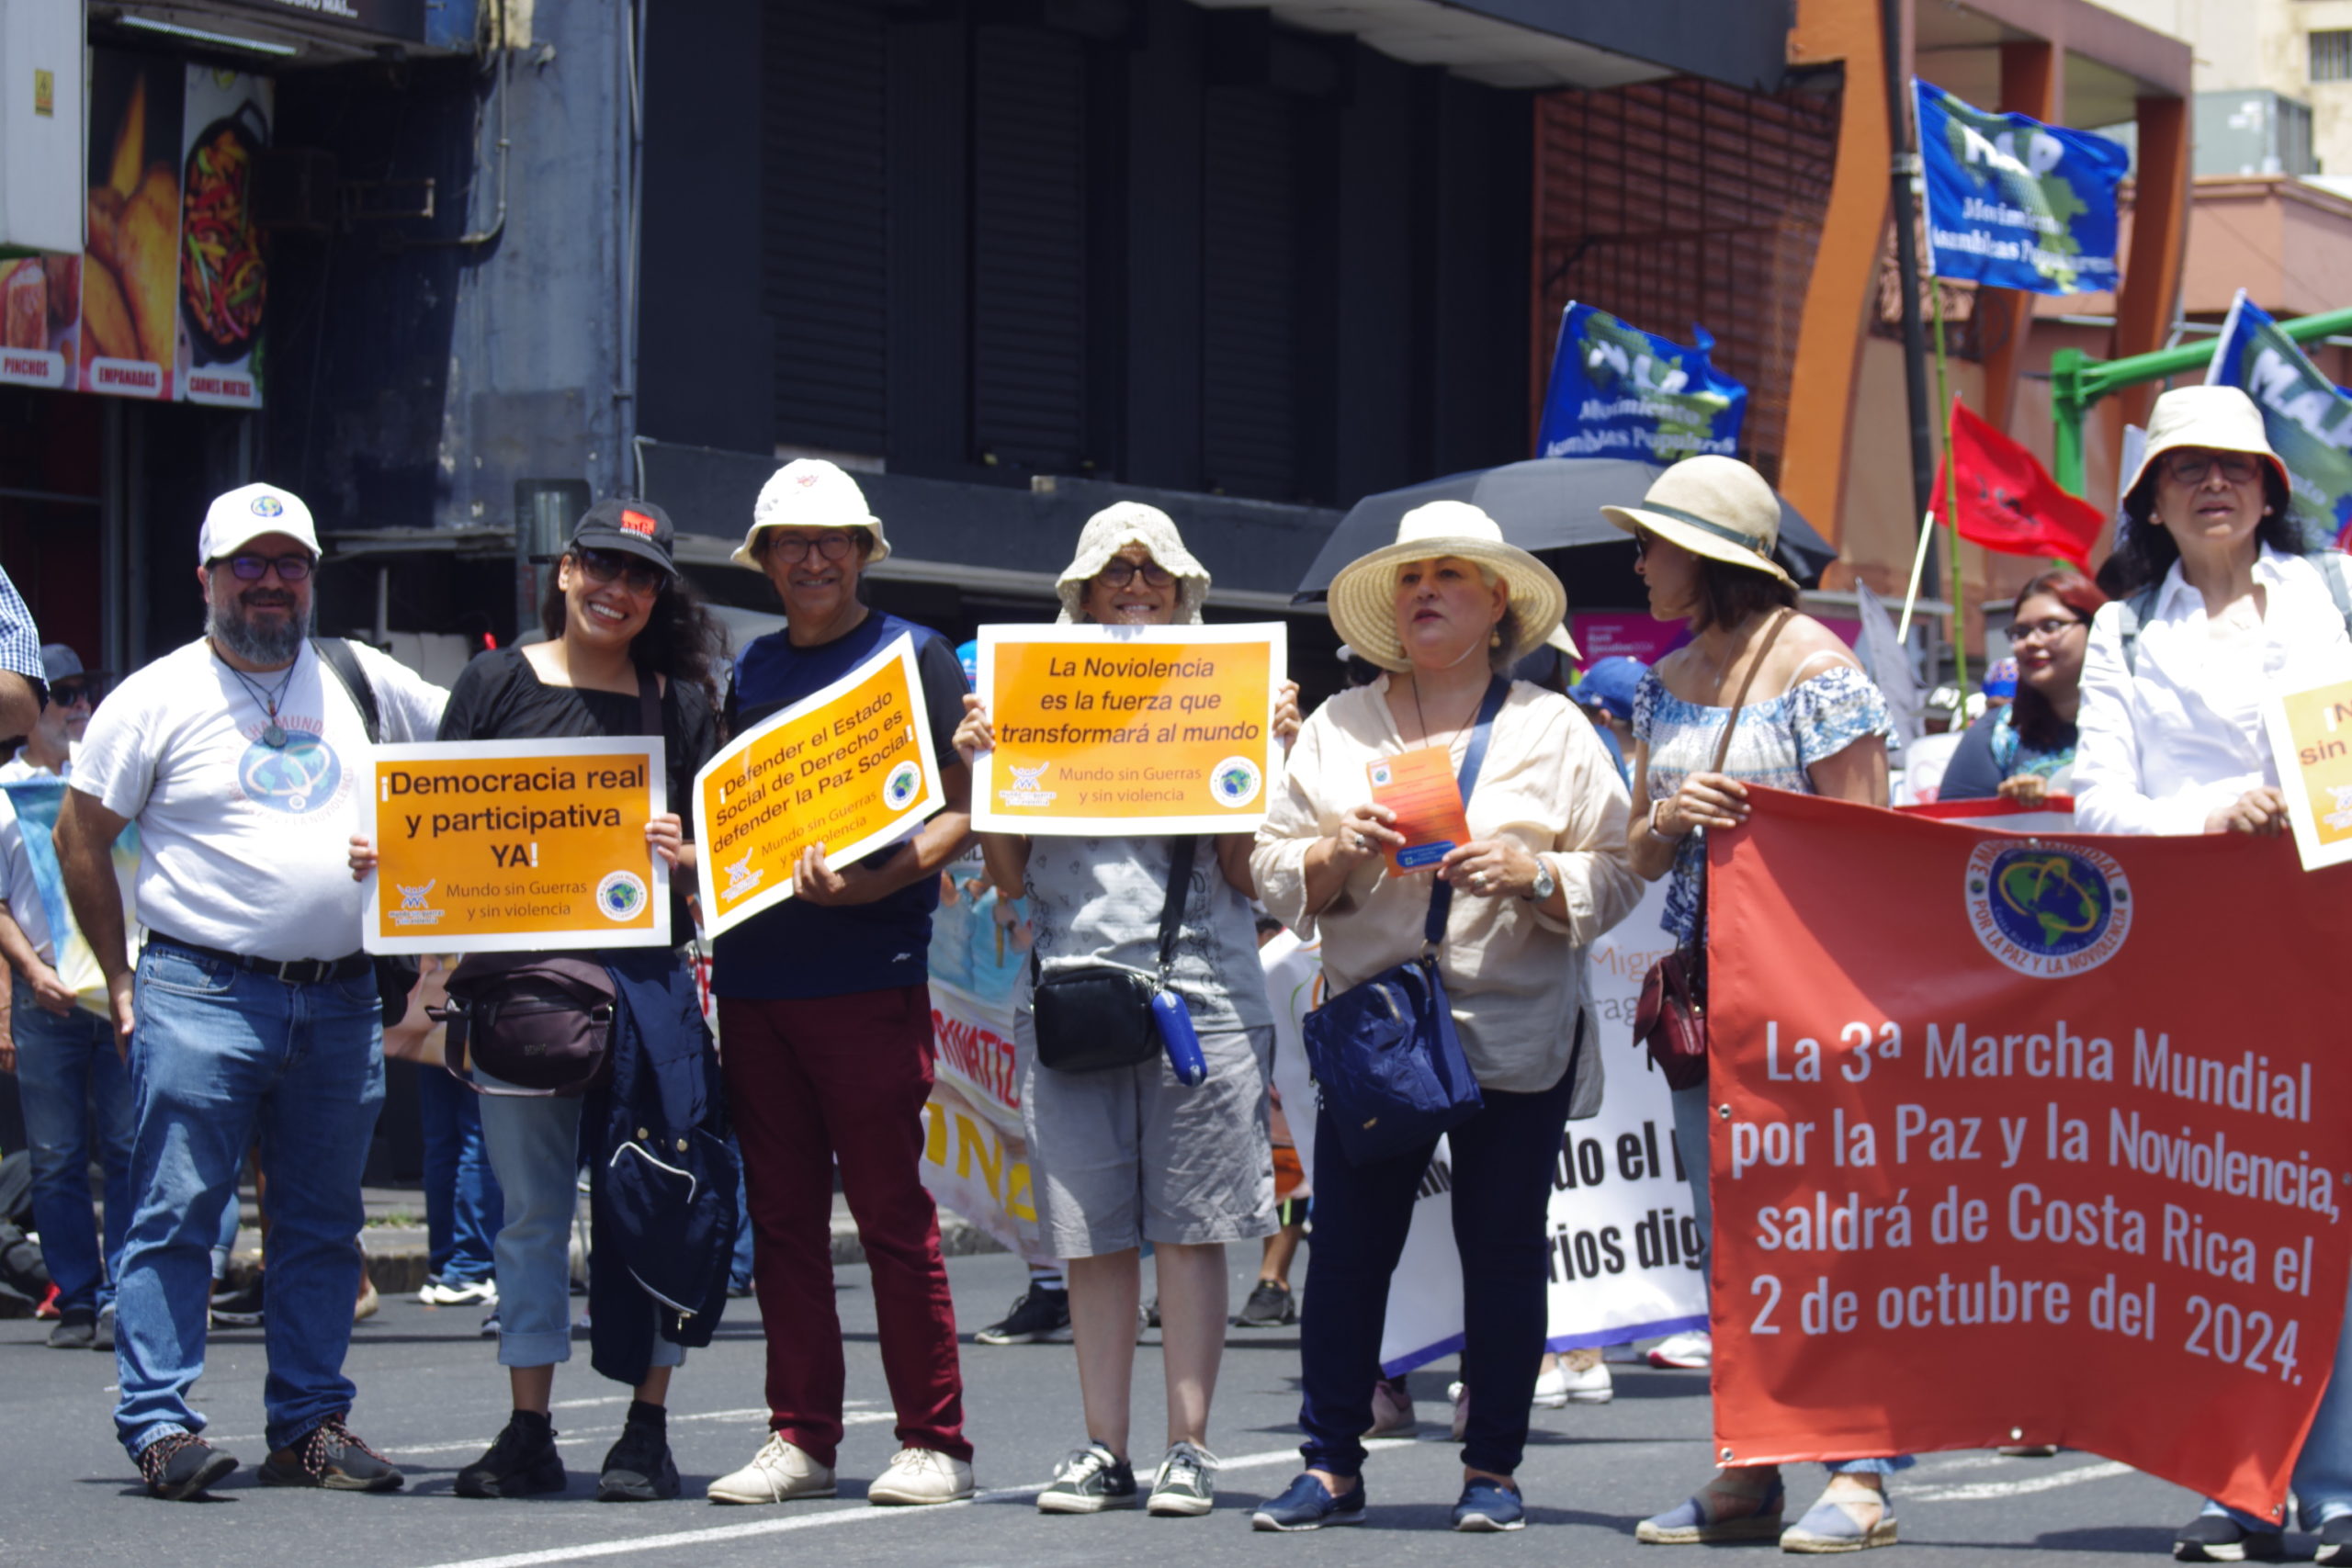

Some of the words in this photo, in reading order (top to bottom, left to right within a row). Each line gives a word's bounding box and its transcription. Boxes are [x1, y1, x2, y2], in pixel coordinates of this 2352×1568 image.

[3, 356, 50, 377] PINCHOS
[98, 367, 156, 388] EMPANADAS
[1048, 657, 1076, 677] La
[1083, 657, 1215, 678] Noviolencia
[1040, 694, 1067, 710] es
[1075, 690, 1093, 710] la
[1102, 689, 1172, 711] fuerza
[1180, 693, 1222, 714] que
[1001, 723, 1149, 744] transformará
[1157, 723, 1177, 743] al
[1182, 720, 1260, 742] mundo
[719, 739, 805, 805] ¡Defender
[811, 727, 829, 748] el
[833, 691, 893, 738] Estado
[2300, 739, 2347, 766] sin
[381, 766, 576, 802] ¡Democracia
[586, 764, 644, 789] real
[716, 784, 766, 828] Social
[772, 766, 795, 792] de
[800, 727, 879, 778] Derecho
[884, 710, 903, 732] es
[1059, 767, 1114, 782] Mundo
[1118, 767, 1139, 781] sin
[1143, 767, 1203, 781] Guerras
[713, 798, 790, 854] defender
[797, 788, 813, 809] la
[818, 769, 854, 795] Paz
[858, 724, 914, 773] Social!
[1079, 791, 1089, 806] y
[1092, 788, 1114, 802] sin
[1117, 788, 1184, 803] violencia
[405, 813, 423, 839] y
[432, 803, 621, 836] participativa
[761, 827, 805, 857] Mundo
[808, 815, 826, 831] sin
[829, 791, 877, 822] Guerras
[490, 842, 538, 869] YA!
[779, 855, 787, 868] y
[447, 881, 501, 898] Mundo
[504, 879, 526, 897] sin
[529, 878, 587, 896] Guerras
[467, 905, 475, 921] y
[479, 902, 501, 918] sin
[505, 900, 571, 918] violencia
[1973, 899, 1993, 931] POR
[1985, 929, 2005, 950] LA
[2001, 942, 2030, 968] PAZ
[2046, 957, 2064, 974] LA
[1766, 1020, 1822, 1082] La
[1839, 1021, 1902, 1083] 3ª
[1924, 1020, 2113, 1082] Marcha
[2132, 1026, 2312, 1122] Mundial
[1616, 1121, 1661, 1181] el
[1731, 1121, 1815, 1180] por
[1834, 1107, 1876, 1168] la
[1895, 1103, 1982, 1165] Paz
[1999, 1116, 2028, 1169] y
[2046, 1101, 2089, 1163] la
[2109, 1106, 2340, 1224] Noviolencia,
[1756, 1187, 1912, 1252] saldrá
[1931, 1184, 1988, 1246] de
[2007, 1182, 2146, 1255] Costa
[2163, 1201, 2256, 1284] Rica
[2273, 1235, 2313, 1298] el
[1750, 1273, 1782, 1336] 2
[1801, 1275, 1859, 1336] de
[1877, 1264, 2071, 1329] octubre
[2088, 1271, 2155, 1342] del
[2184, 1294, 2302, 1386] 2024.
